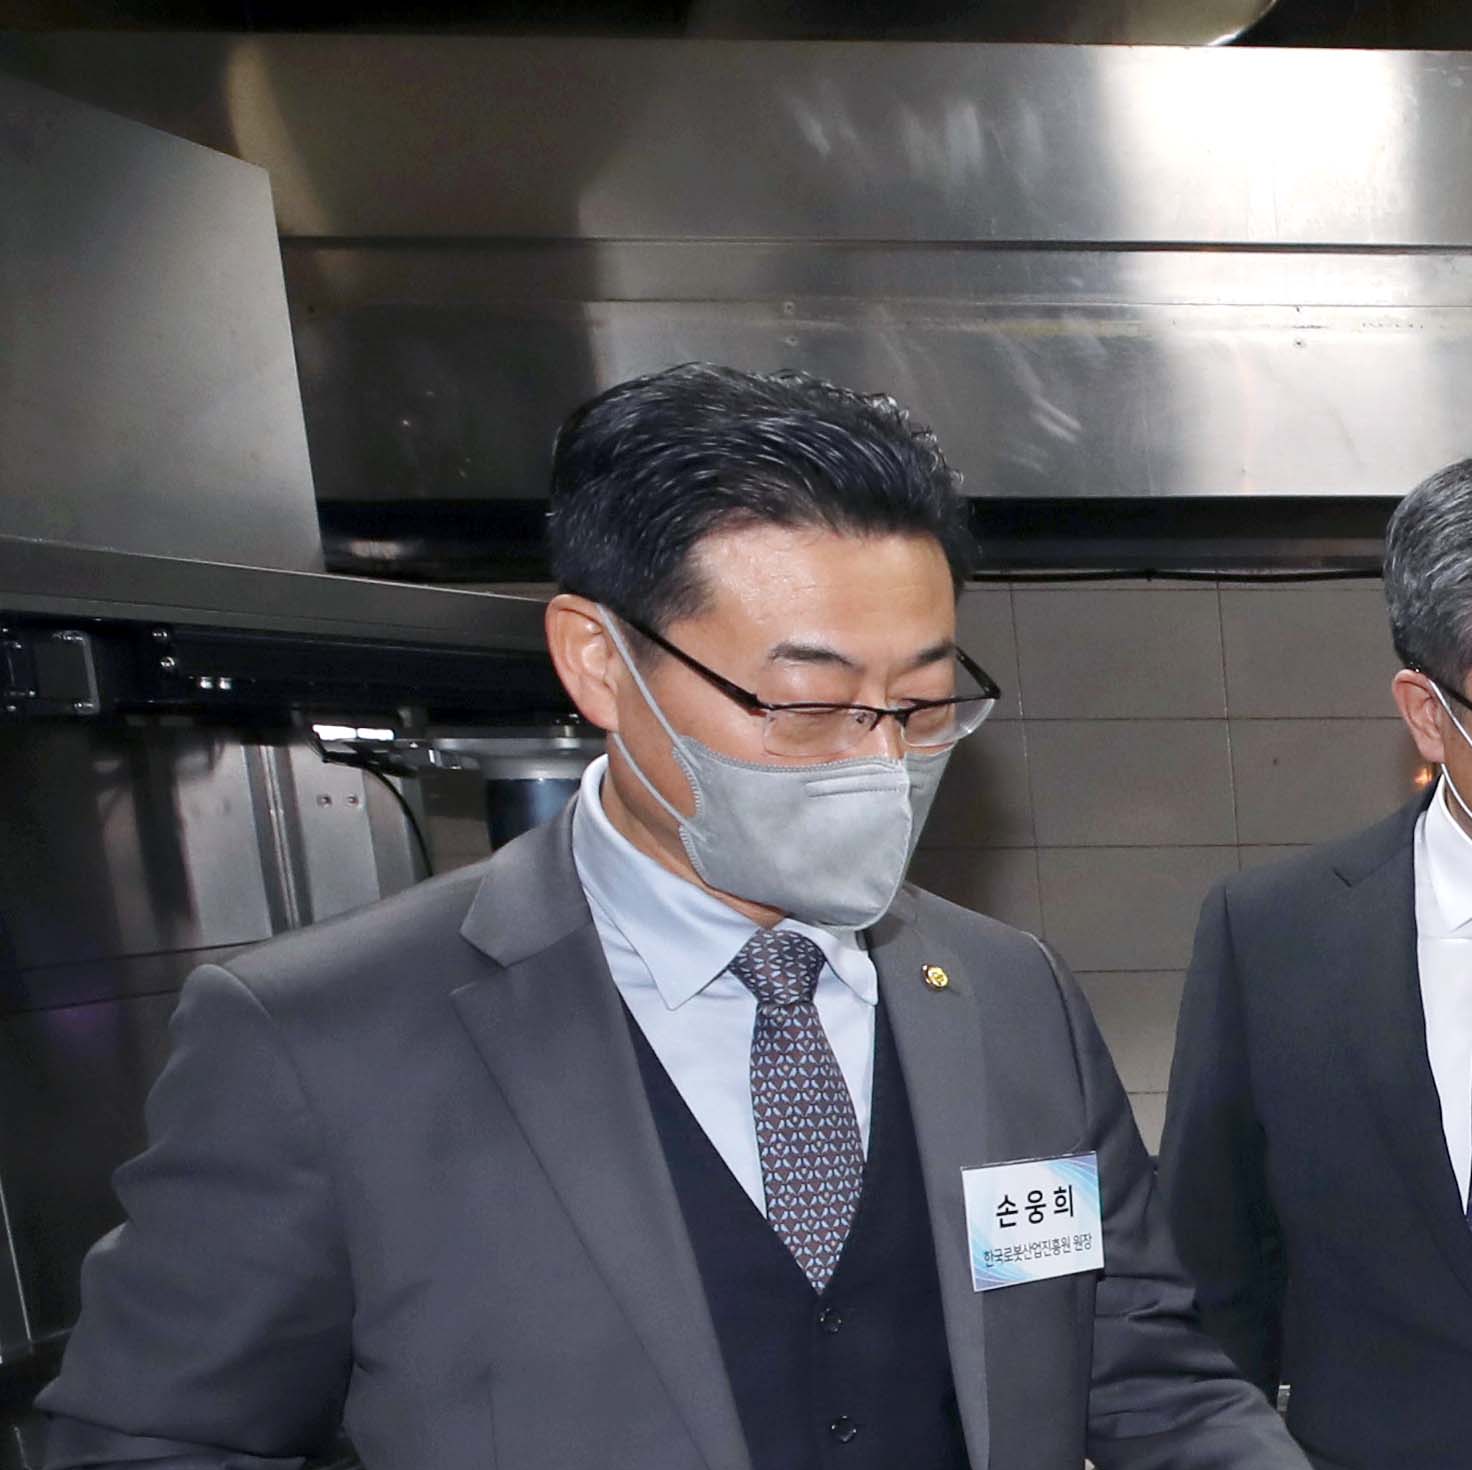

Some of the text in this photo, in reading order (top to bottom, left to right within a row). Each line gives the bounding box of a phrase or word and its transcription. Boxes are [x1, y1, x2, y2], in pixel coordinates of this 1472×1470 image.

[996, 1184, 1074, 1229] 손웅희
[983, 1232, 1093, 1268] 한국로봇산업진흥원 원장
